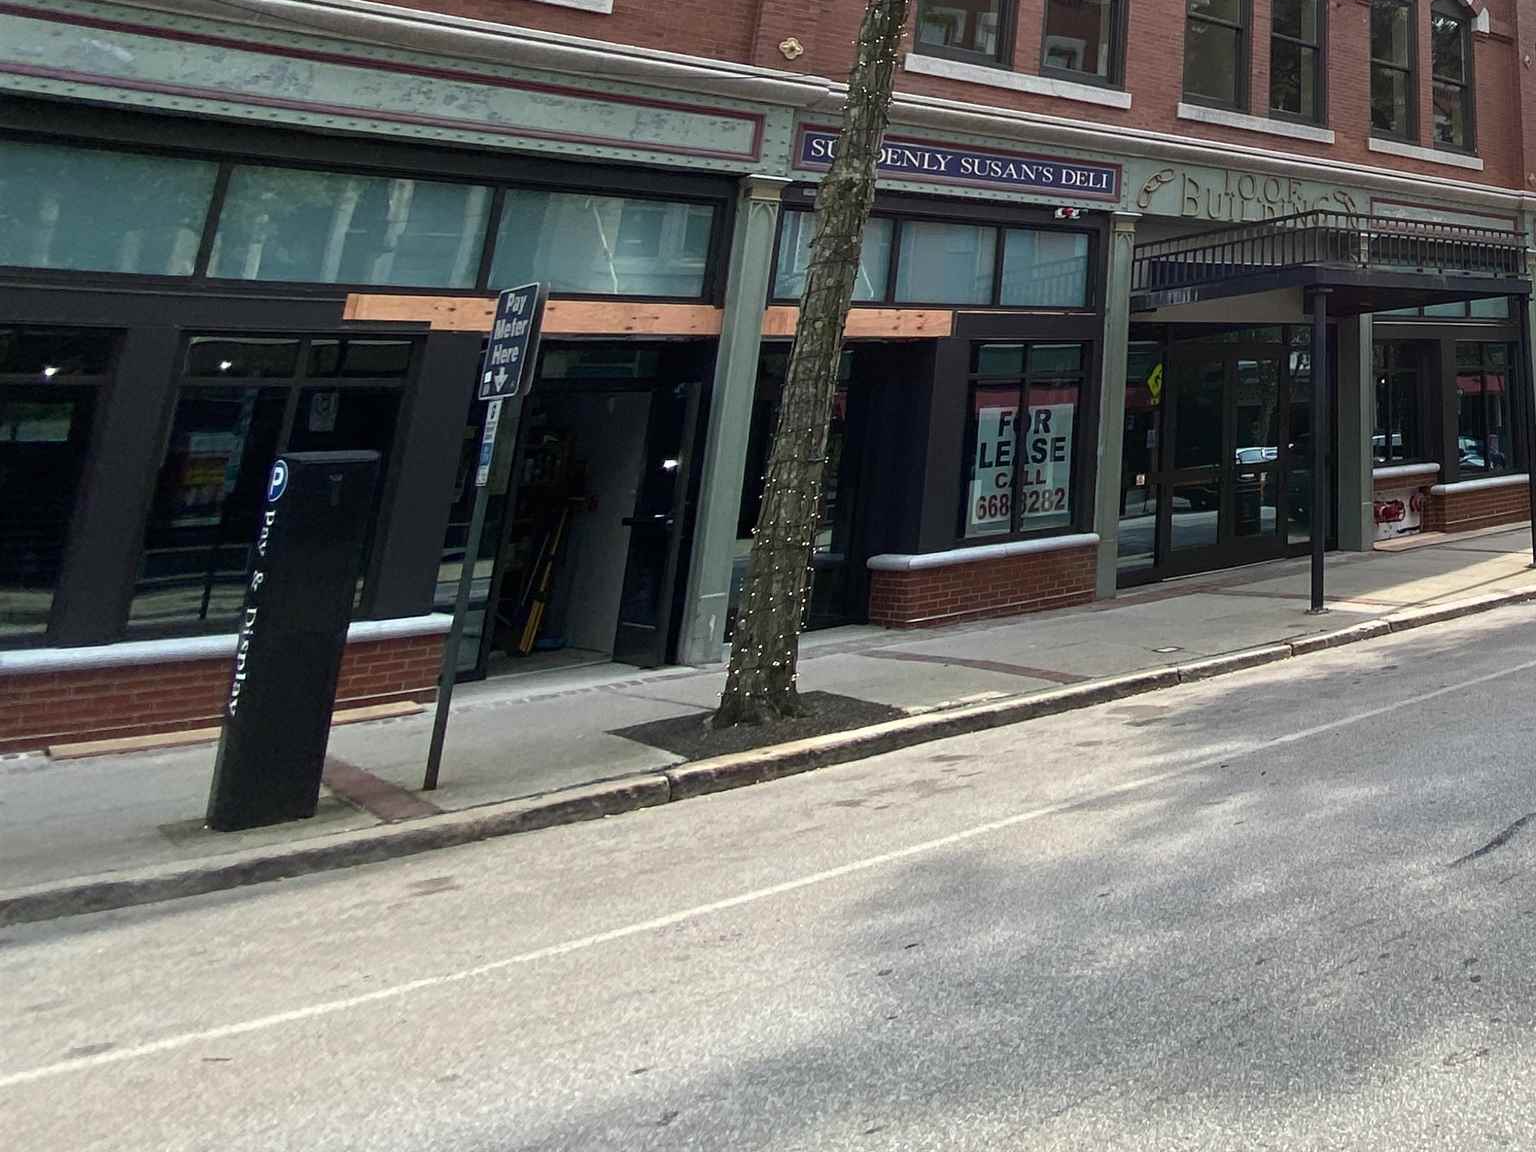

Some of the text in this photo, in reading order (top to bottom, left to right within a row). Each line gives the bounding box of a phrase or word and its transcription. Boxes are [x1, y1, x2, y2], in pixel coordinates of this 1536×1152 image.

[960, 156, 1054, 184] SUSAN'S
[1060, 168, 1109, 189] DELI
[504, 292, 527, 316] Pay
[493, 317, 528, 341] Meter
[491, 343, 519, 365] Here
